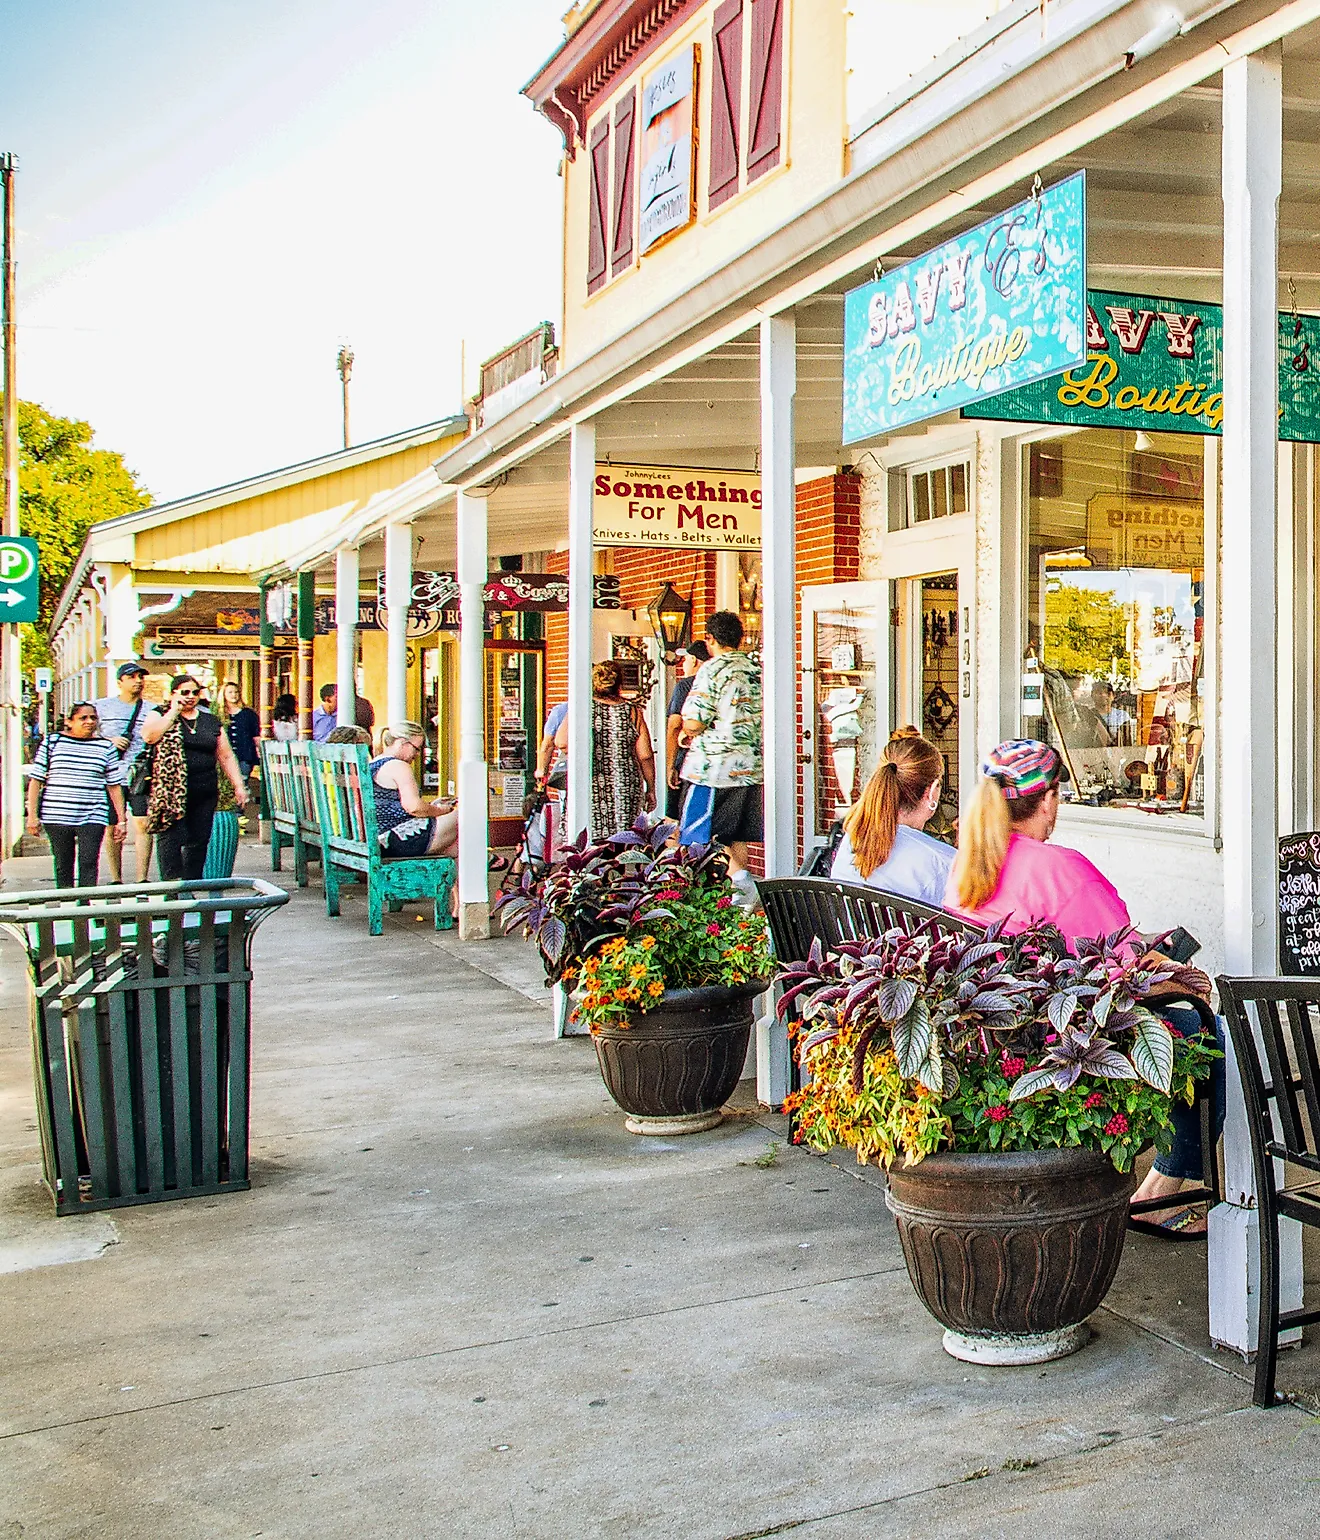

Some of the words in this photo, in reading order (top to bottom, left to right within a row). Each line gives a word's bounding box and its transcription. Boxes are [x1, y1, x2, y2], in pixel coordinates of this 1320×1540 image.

[868, 251, 972, 348] SAVY
[984, 200, 1048, 298] E's
[1087, 304, 1202, 359] VY
[888, 326, 1028, 405] Boutique
[1057, 354, 1226, 428] Boutiq
[595, 475, 762, 510] Something
[629, 502, 665, 520] For
[677, 504, 738, 530] Men
[640, 530, 669, 541] Hats
[682, 532, 711, 542] Belts
[723, 534, 762, 545] Wallet
[1287, 908, 1320, 932] great
[1286, 934, 1302, 947] at
